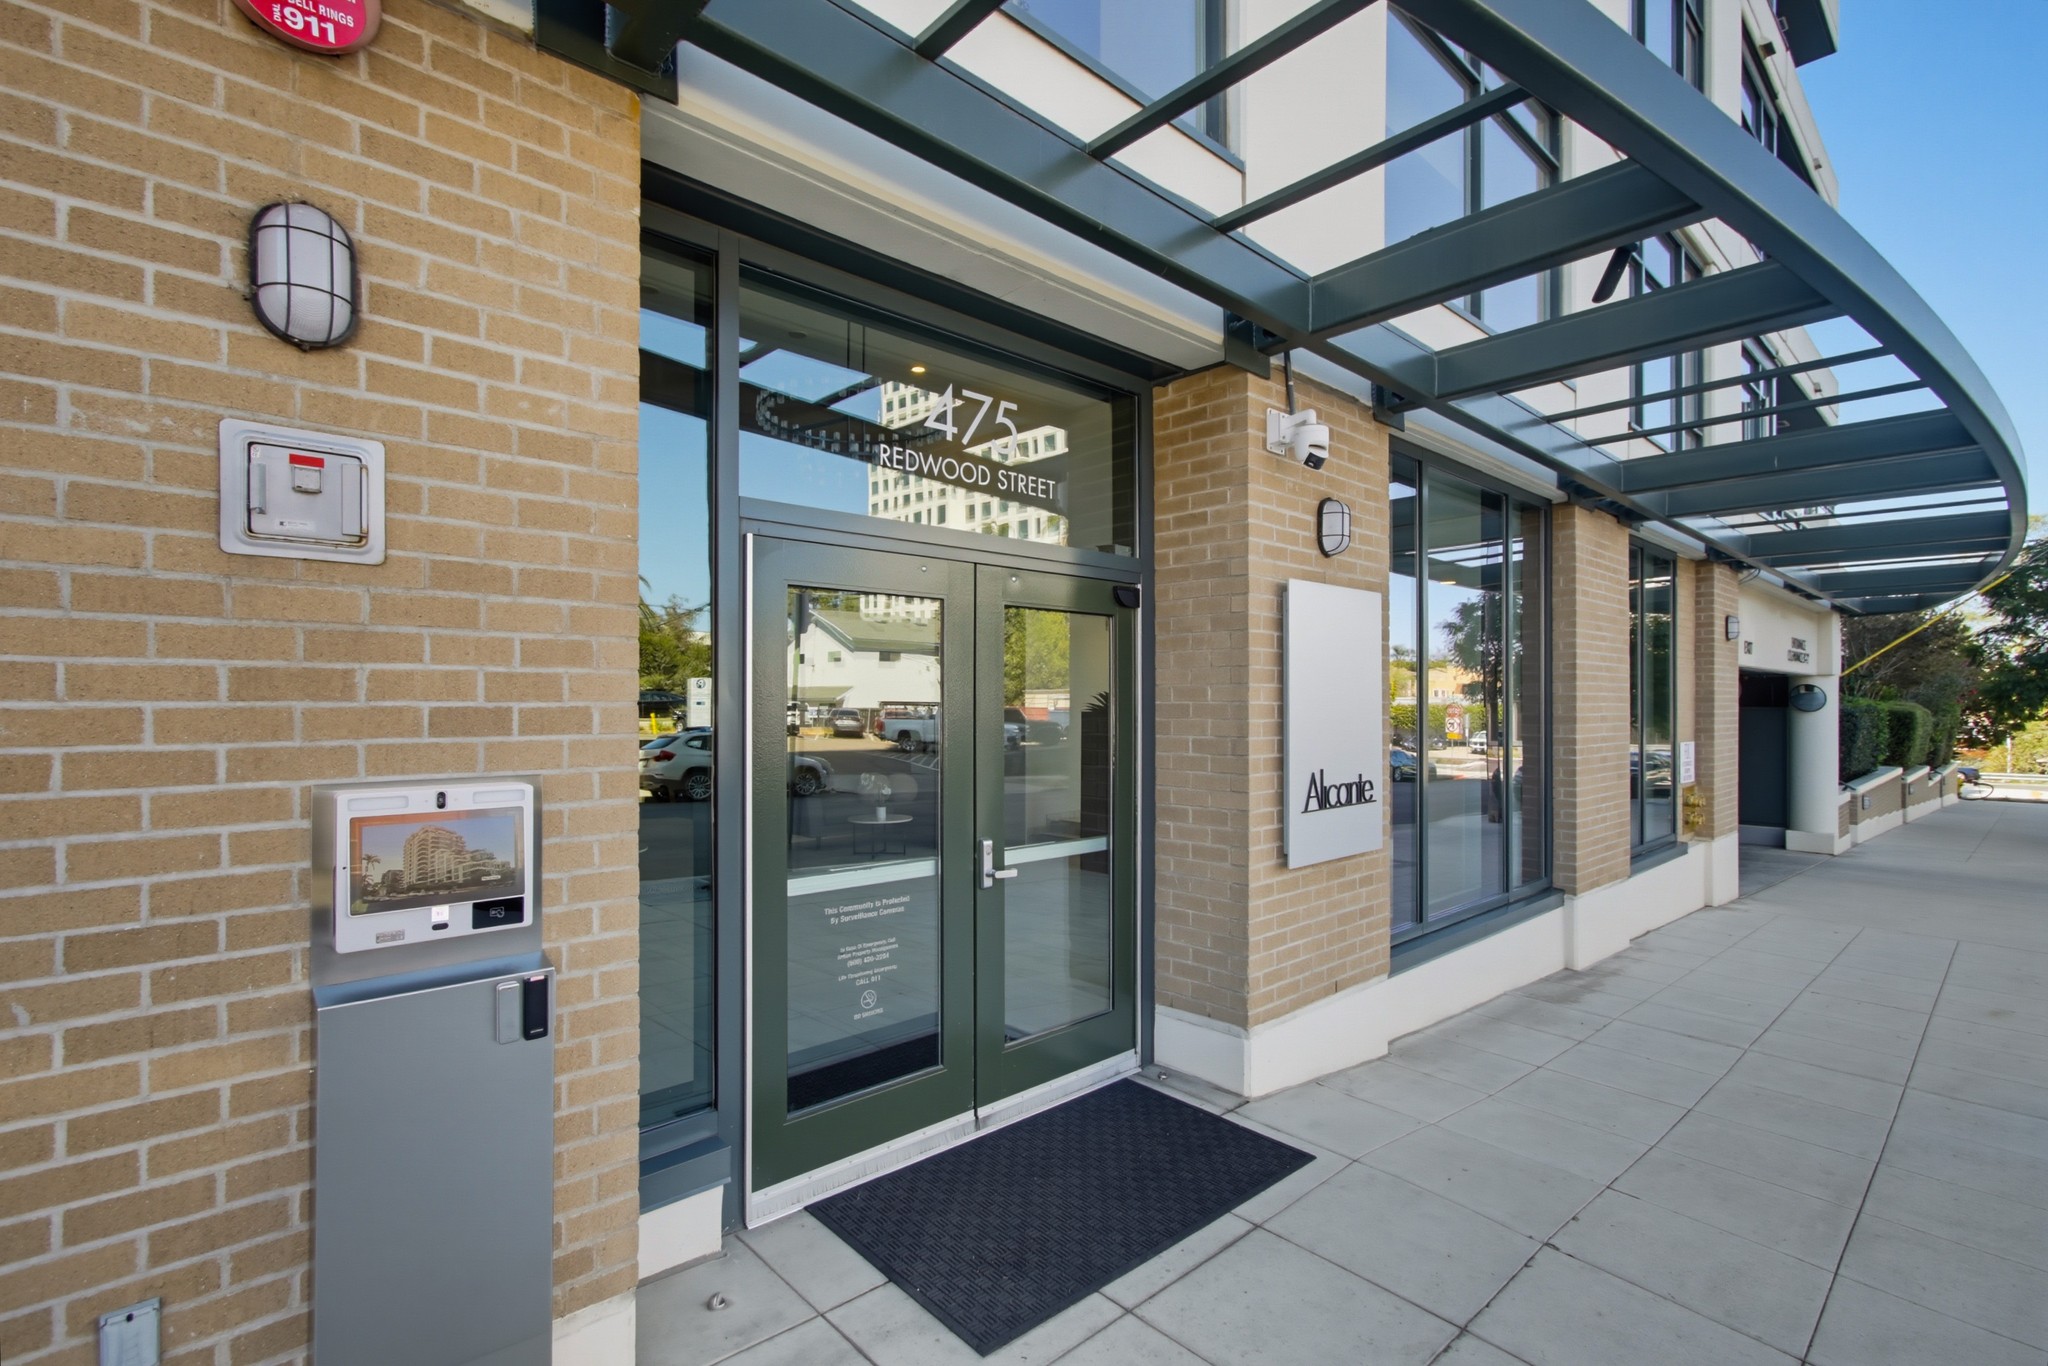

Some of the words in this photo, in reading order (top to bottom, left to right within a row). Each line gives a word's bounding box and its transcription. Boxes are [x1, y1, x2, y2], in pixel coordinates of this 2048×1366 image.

[283, 6, 336, 44] 911
[318, 4, 354, 28] RINGS
[923, 383, 1018, 455] 475
[879, 443, 991, 486] REDWOOD
[997, 470, 1056, 499] STREET
[1303, 768, 1376, 813] Alicante
[824, 907, 838, 915] This
[839, 902, 874, 913] Community
[882, 895, 910, 906] Protected
[830, 917, 839, 925] By
[840, 911, 878, 922] Surveillance
[879, 906, 905, 916] Cameras
[855, 977, 870, 986] CALL
